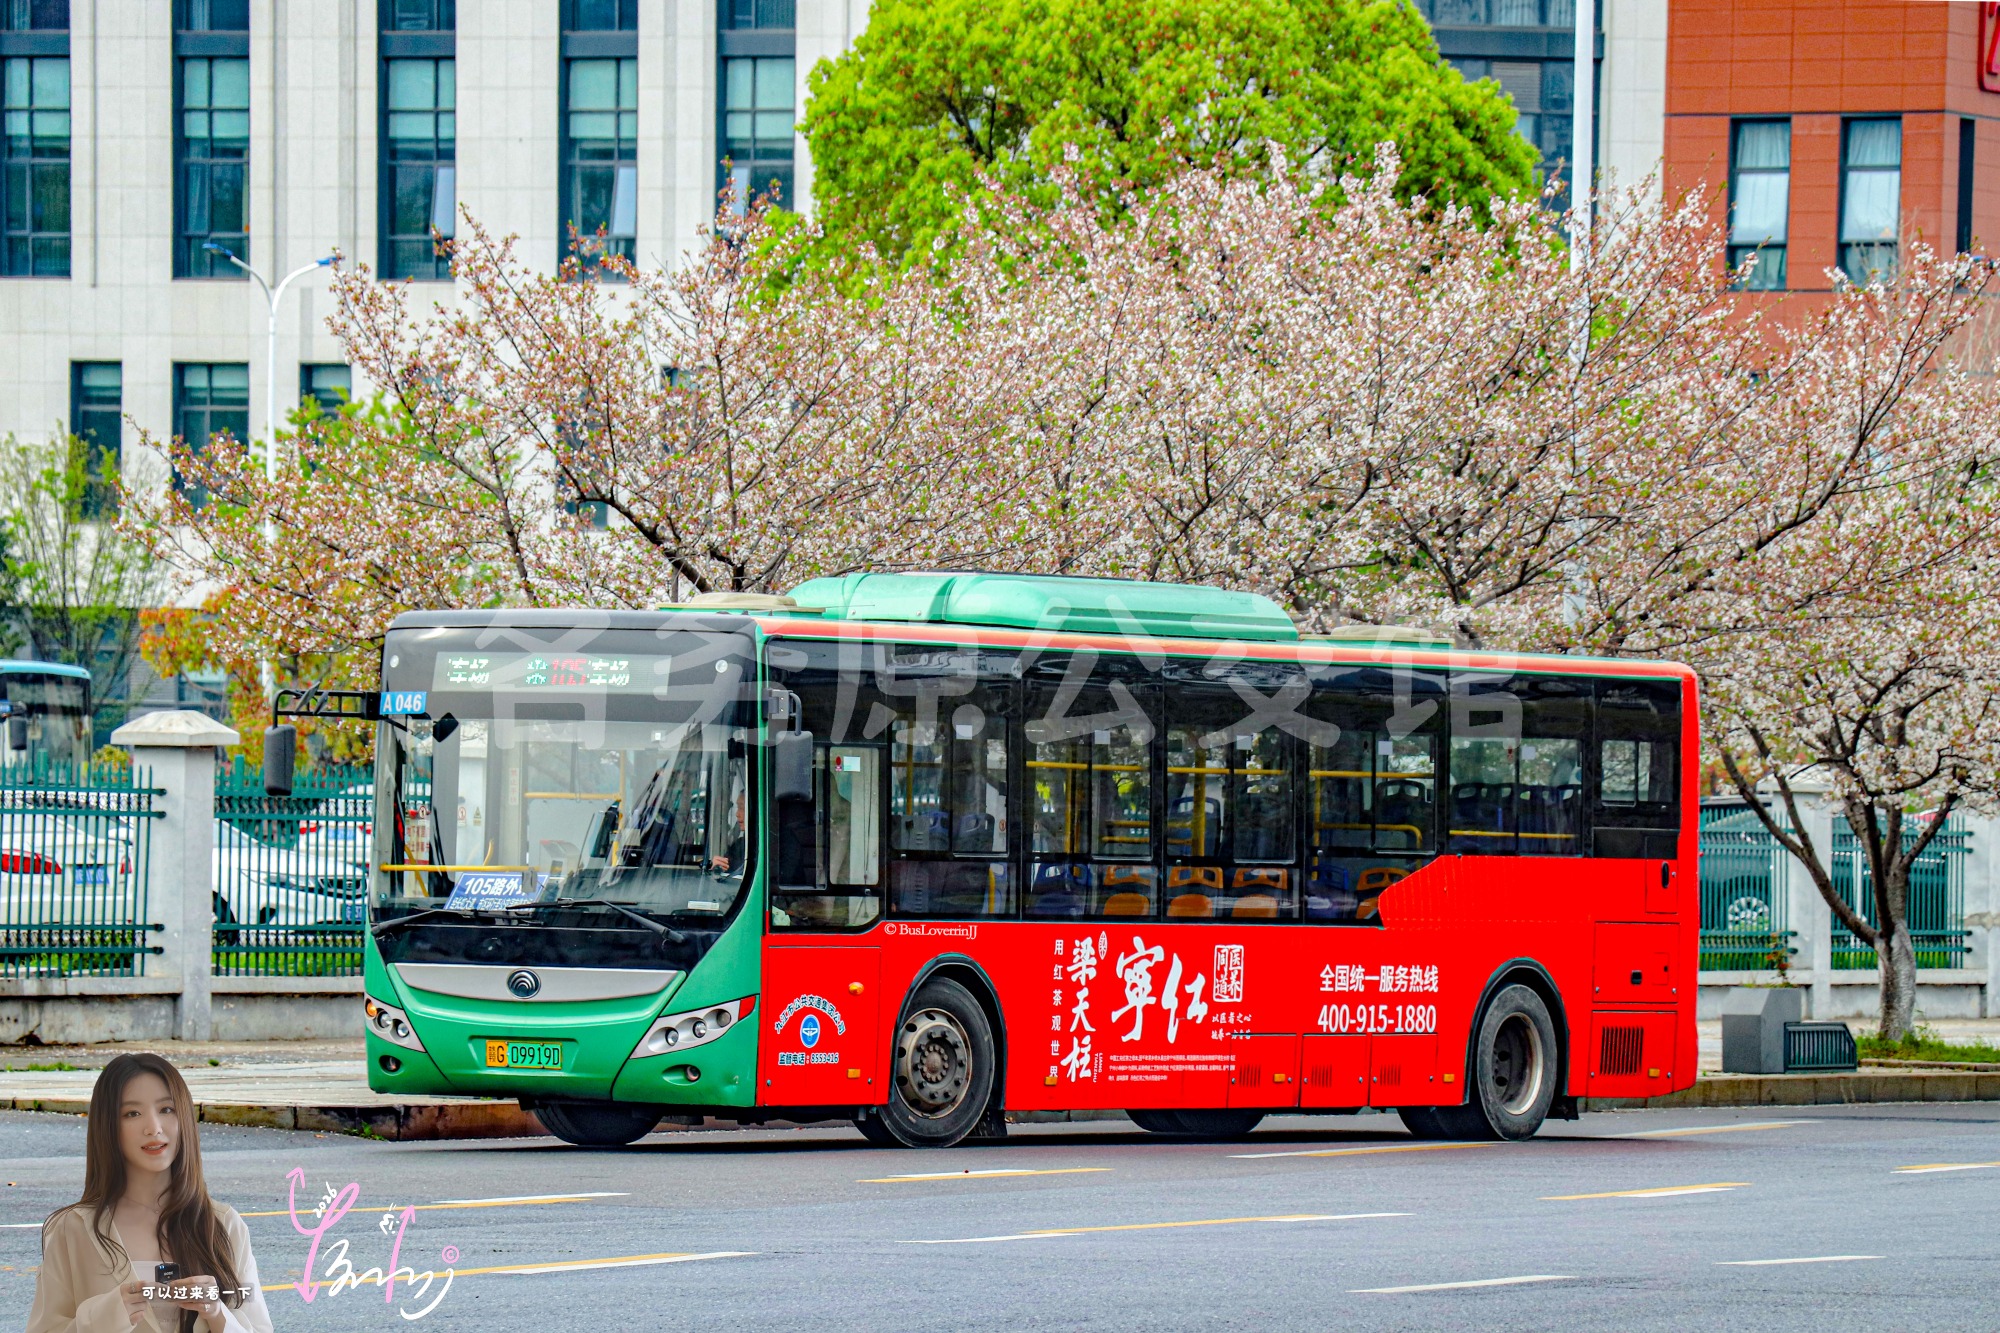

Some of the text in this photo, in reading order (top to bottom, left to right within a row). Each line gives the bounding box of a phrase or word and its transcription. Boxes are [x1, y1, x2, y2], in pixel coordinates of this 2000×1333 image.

[382, 693, 422, 712] A 046
[1319, 964, 1439, 993] 全国统一服务热线
[1049, 939, 1064, 1078] 用红茶观世界
[1060, 936, 1097, 1083] 梁天柱
[1317, 1004, 1437, 1033] 400-915-1880
[511, 1045, 560, 1066] 09919D
